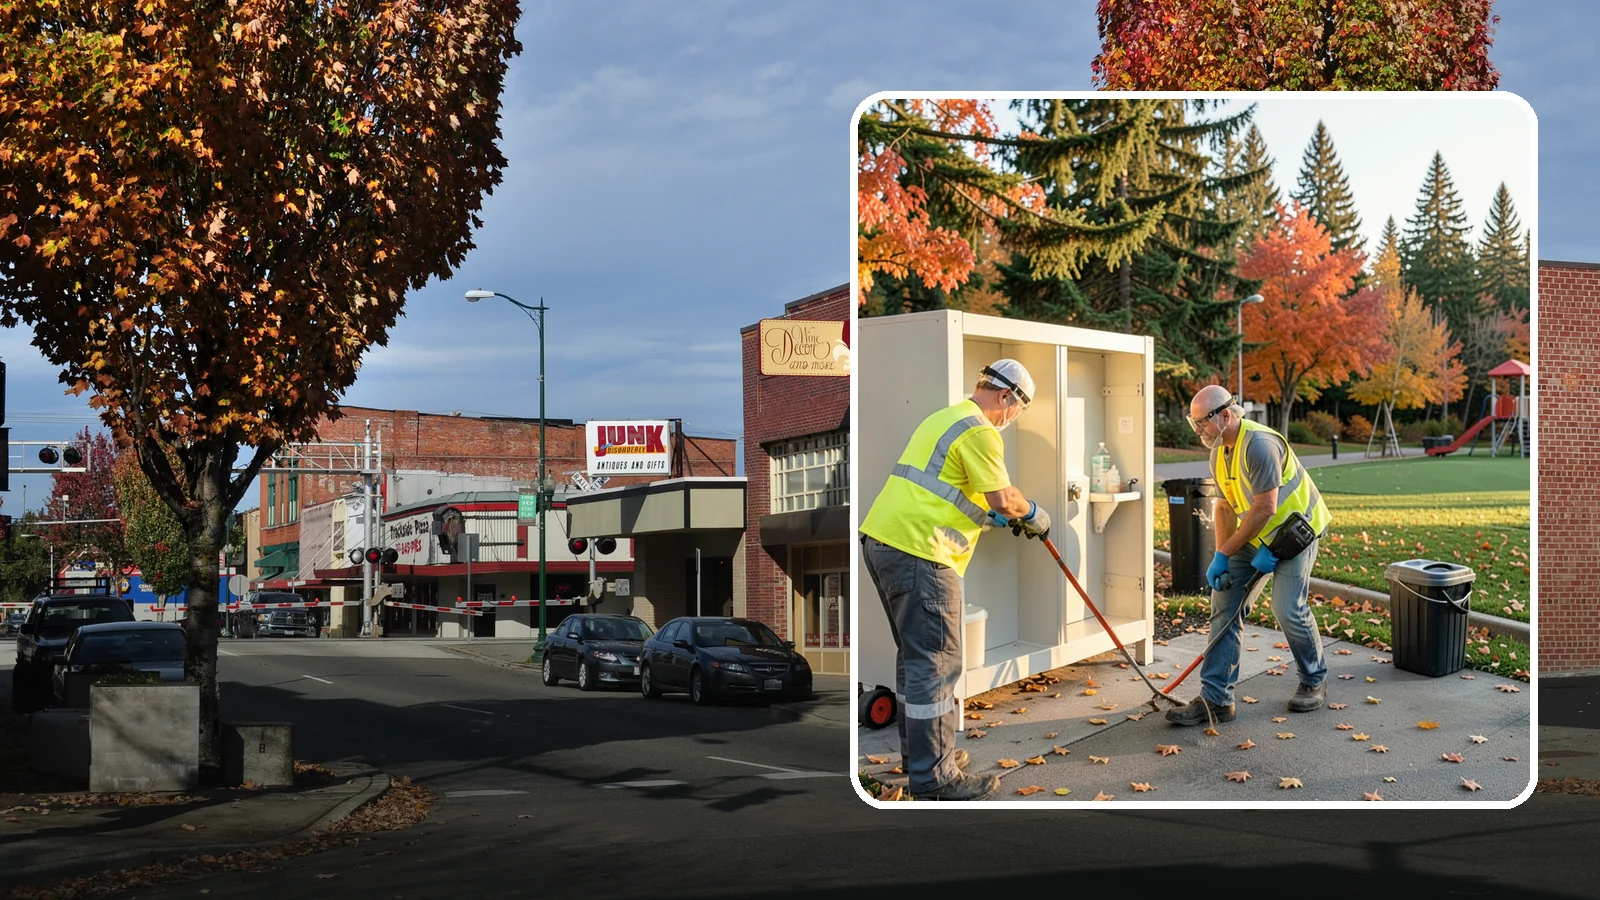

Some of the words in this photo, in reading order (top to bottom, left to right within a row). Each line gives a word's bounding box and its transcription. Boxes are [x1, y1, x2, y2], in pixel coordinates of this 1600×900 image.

[765, 328, 831, 365] Decor
[596, 425, 665, 457] JUNK
[597, 461, 628, 470] ANTIQUES
[631, 461, 644, 470] AND
[647, 461, 665, 470] GIFTS
[574, 473, 588, 490] RAIL
[590, 475, 609, 491] SING
[353, 498, 364, 510] CRO
